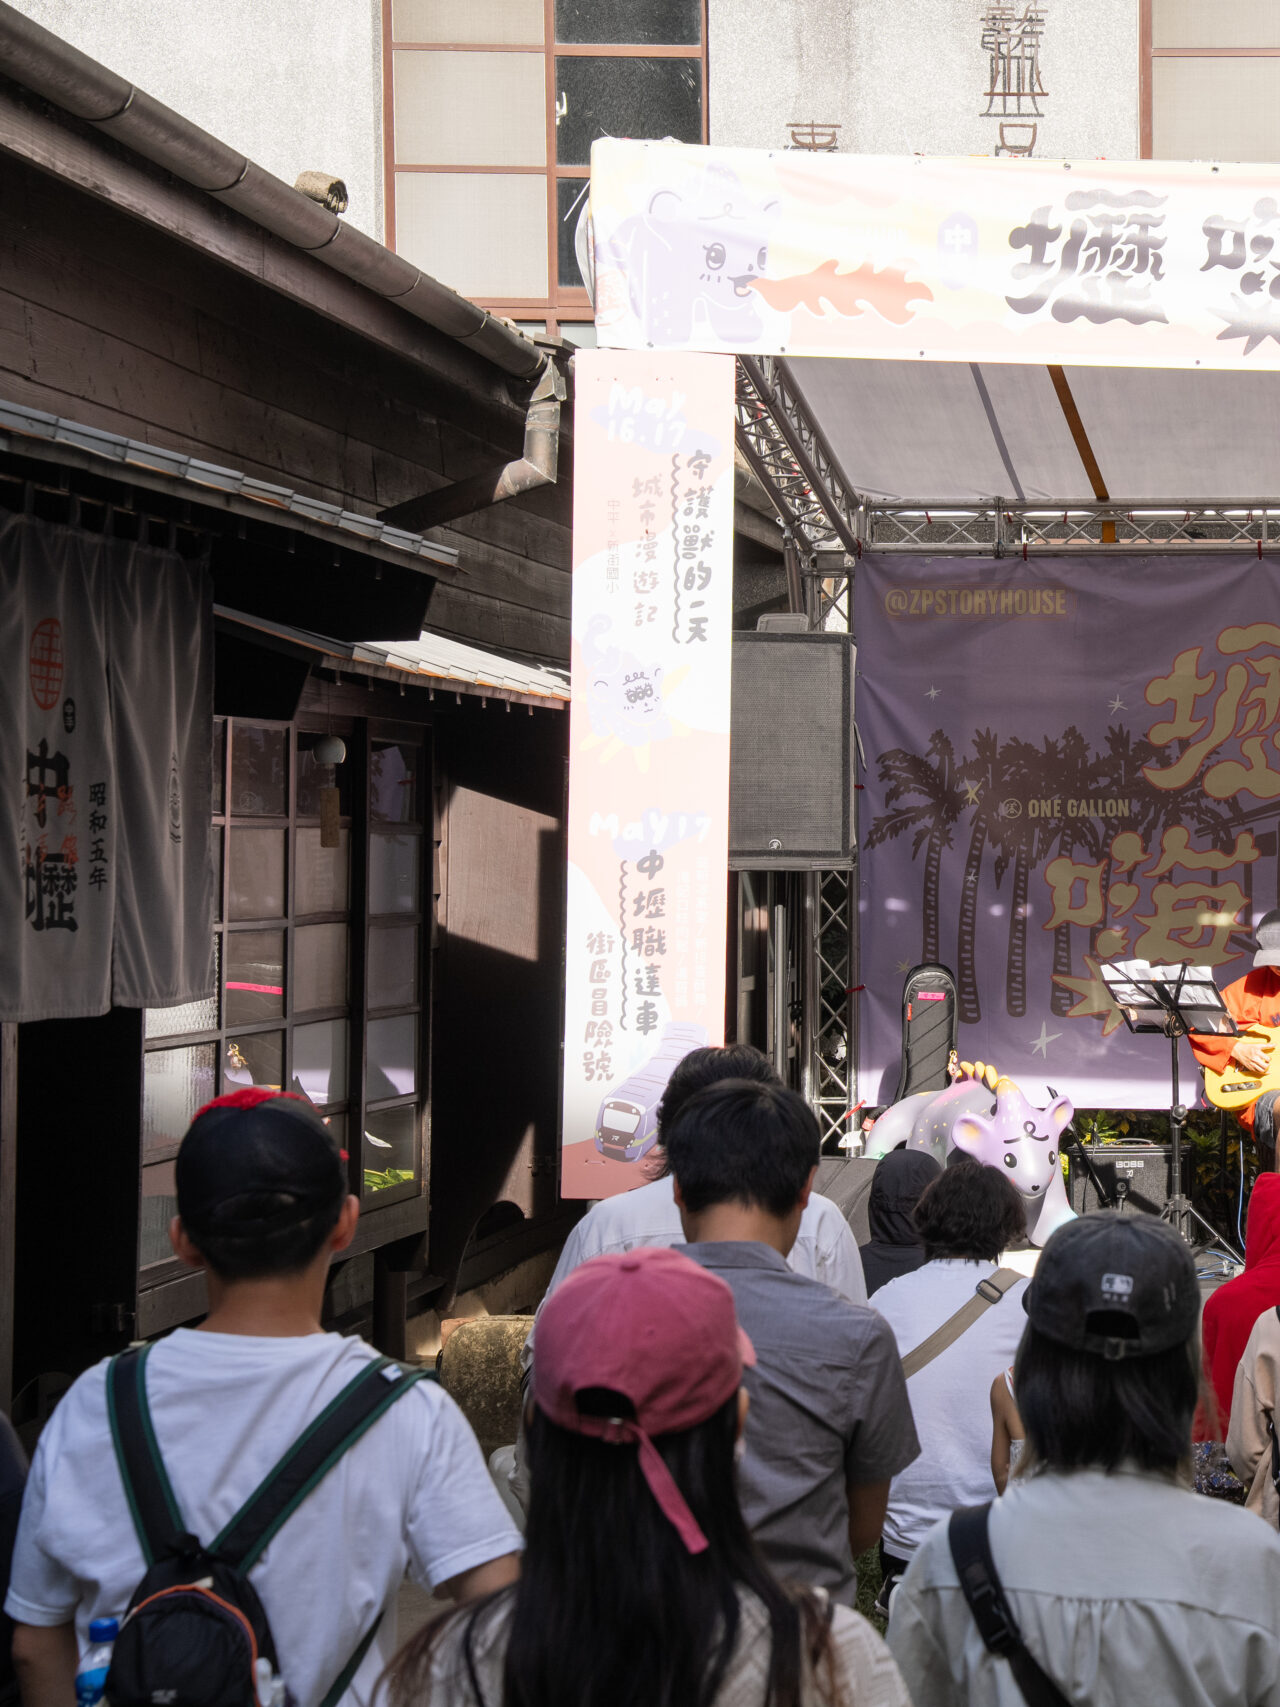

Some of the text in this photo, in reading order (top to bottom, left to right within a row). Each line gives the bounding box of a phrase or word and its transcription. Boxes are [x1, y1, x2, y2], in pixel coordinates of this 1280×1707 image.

[608, 384, 687, 420] May
[631, 472, 663, 628] 城市漫遊記
[683, 449, 714, 645] 守護獸的一天
[884, 588, 1067, 617] @ZPSTORYHOUSE
[88, 782, 107, 891] 昭和五年
[1028, 798, 1129, 818] ONE GALLON
[582, 931, 616, 1083] 街區冒險號
